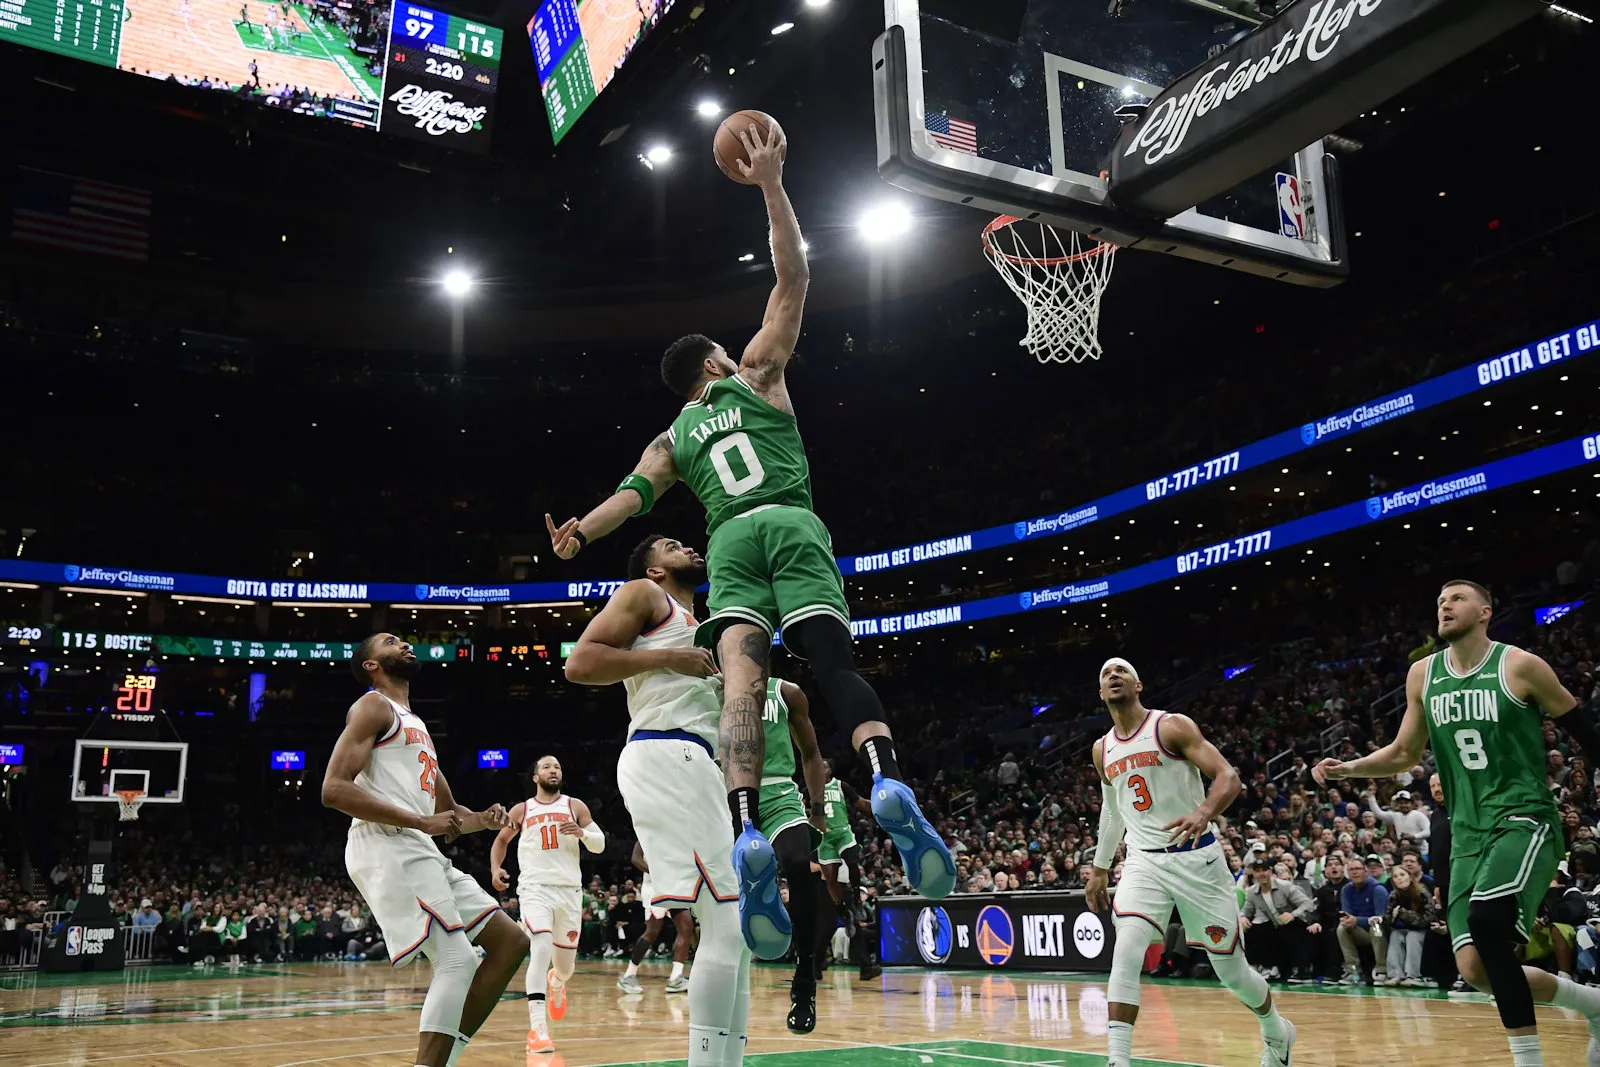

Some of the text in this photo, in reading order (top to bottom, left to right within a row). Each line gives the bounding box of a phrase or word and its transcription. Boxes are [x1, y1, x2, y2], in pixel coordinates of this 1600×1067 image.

[405, 18, 434, 39] 97
[458, 32, 494, 57] 115
[395, 52, 405, 62] 21
[425, 58, 464, 80] 2:20
[475, 74, 490, 85] 4th
[1124, 0, 1383, 165] Different Here
[388, 84, 487, 121] Different
[415, 109, 474, 135] Here
[1477, 347, 1534, 386] GOTTA
[1536, 333, 1571, 365] GET
[689, 407, 742, 444] TATUM
[1361, 404, 1415, 428] INJURY LAWYERS
[709, 431, 765, 497] 0
[1146, 451, 1240, 500] 617-777-7777
[1430, 484, 1487, 505] INJURY LAWYERS
[855, 534, 972, 572] GOTTA GET GLASSMAN
[1176, 530, 1272, 573] 617-777-7777
[227, 579, 367, 599] GOTTA GET GLASSMAN
[881, 617, 902, 633] GET
[904, 606, 961, 630] GLASSMAN
[8, 626, 42, 640] 2:20
[62, 632, 97, 648] 115
[215, 647, 221, 656] 2
[234, 648, 240, 656] 2
[310, 649, 332, 658] 16/41
[458, 649, 468, 657] 21
[511, 646, 528, 655] 2:20
[124, 674, 156, 690] 2:20
[117, 687, 152, 712] 20
[1430, 689, 1499, 728] BOSTON
[123, 714, 155, 722] TISSOT
[276, 755, 300, 763] ULTRA
[1454, 728, 1488, 770] 8
[1105, 750, 1163, 781] NEW YORK
[1127, 774, 1153, 812] 3
[824, 802, 834, 818] 4
[540, 824, 559, 851] 11
[91, 873, 104, 884] THE
[92, 864, 105, 874] GET
[93, 884, 106, 896] App
[83, 927, 115, 943] League
[957, 924, 970, 949] VS
[1022, 915, 1065, 957] NEXT
[1076, 926, 1102, 941] abc
[81, 941, 104, 955] Pass
